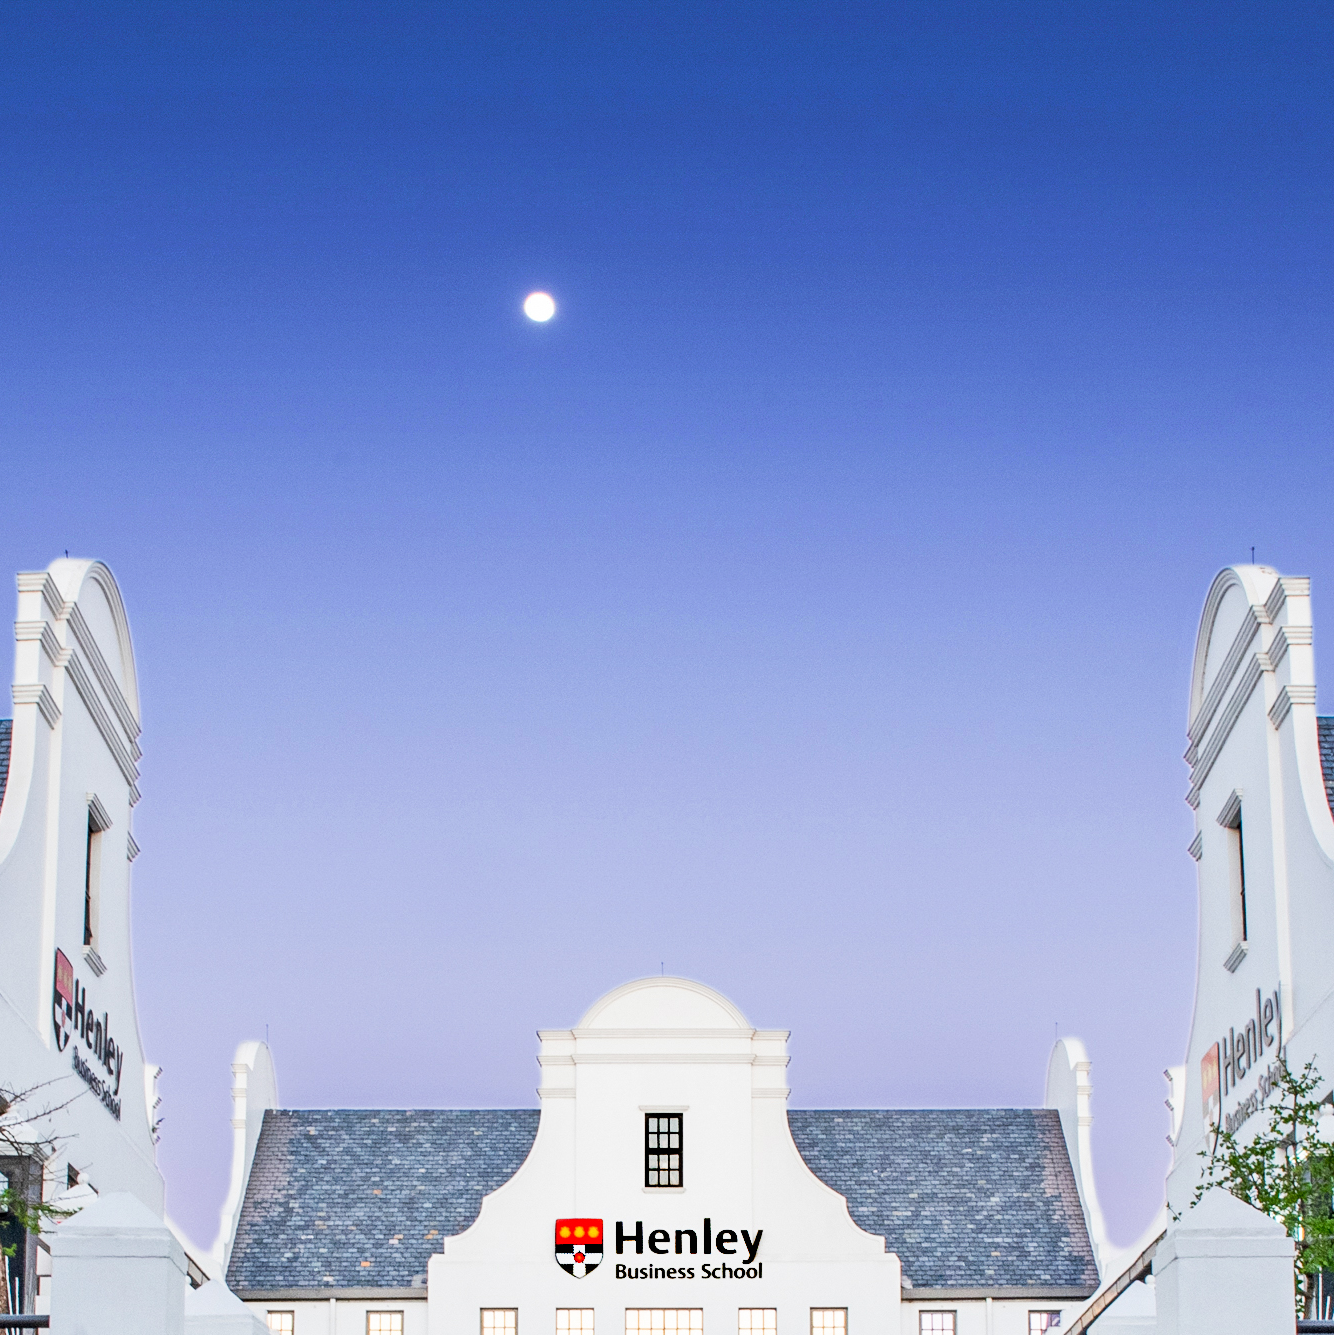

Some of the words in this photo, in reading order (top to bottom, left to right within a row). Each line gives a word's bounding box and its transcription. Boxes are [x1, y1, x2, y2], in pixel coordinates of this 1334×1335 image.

[74, 978, 123, 1096] Henley
[1222, 980, 1282, 1096] Henley
[72, 1045, 102, 1097] Business
[100, 1080, 122, 1122] School
[615, 1218, 764, 1264] Henley
[615, 1263, 695, 1279] Business
[701, 1262, 763, 1279] School
